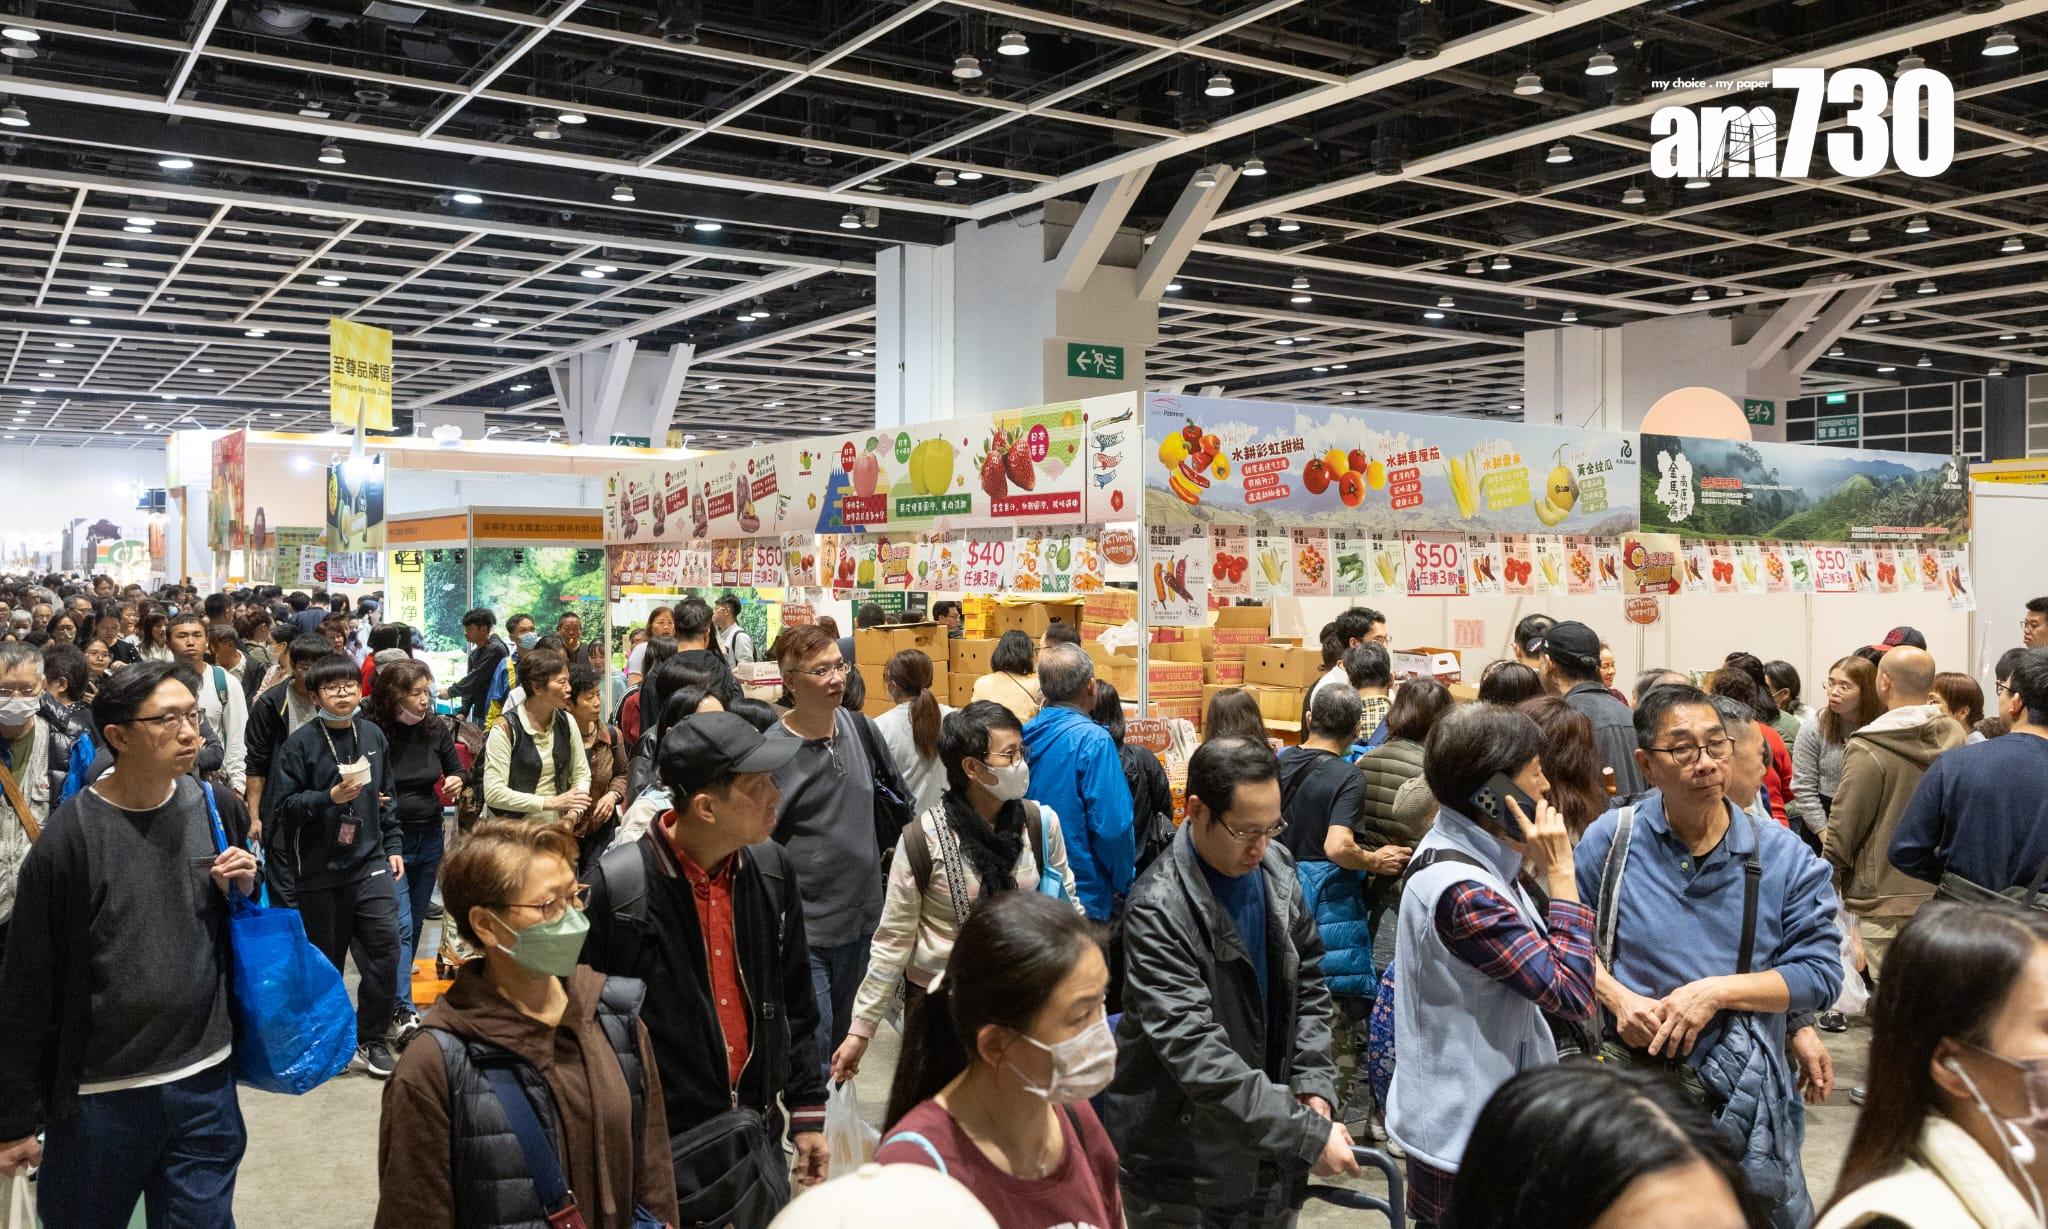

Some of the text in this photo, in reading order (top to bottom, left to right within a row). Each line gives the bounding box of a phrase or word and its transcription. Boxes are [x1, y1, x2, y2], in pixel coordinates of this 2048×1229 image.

[333, 356, 390, 382] 至尊品牌區
[333, 381, 357, 392] Premium
[1818, 417, 1857, 428] EMERGENCY EXIT
[1031, 431, 1045, 441] 日本
[1818, 427, 1857, 439] 緊急出口
[1231, 437, 1305, 462] 水耕彩虹甜椒
[1386, 446, 1440, 468] 水耕車厘茄
[660, 549, 681, 568] $60
[757, 544, 783, 568] $60
[967, 538, 1005, 568] $40
[1415, 540, 1458, 571] $50
[1815, 549, 1846, 571] $50
[964, 570, 999, 587] 任揀3款
[1419, 568, 1459, 587] 任揀3款
